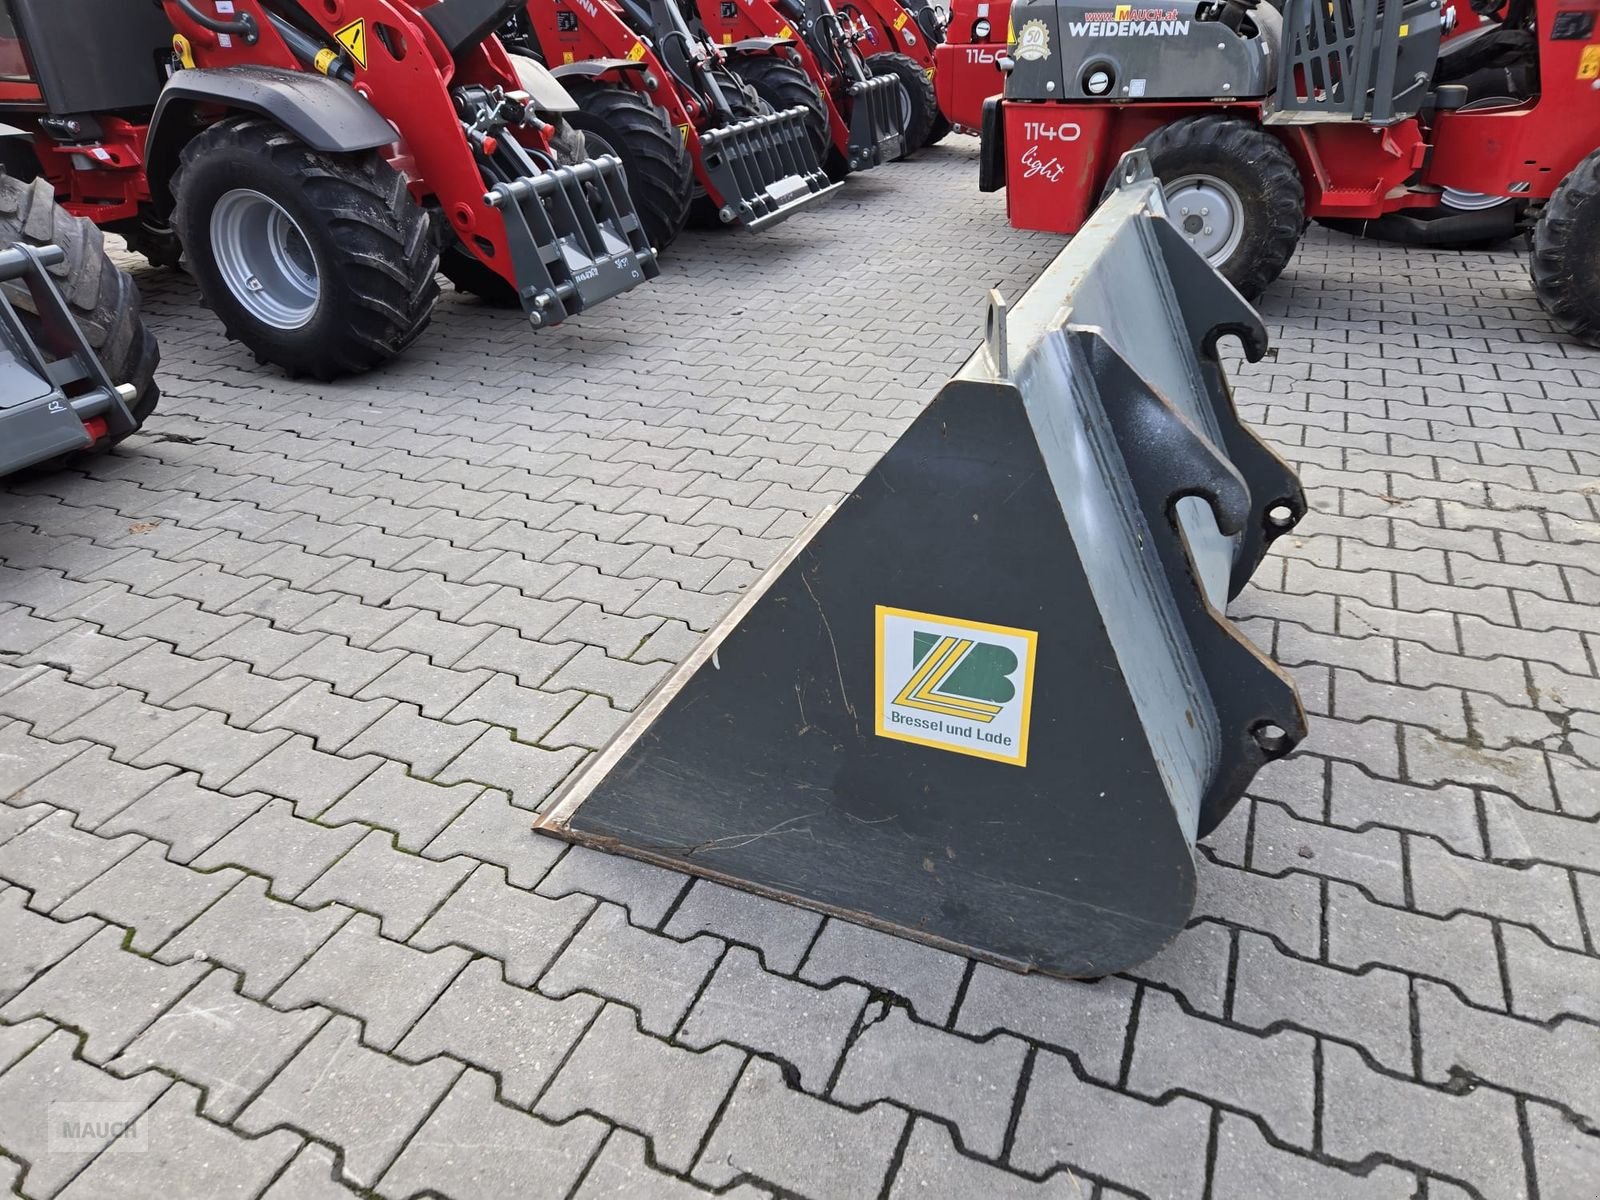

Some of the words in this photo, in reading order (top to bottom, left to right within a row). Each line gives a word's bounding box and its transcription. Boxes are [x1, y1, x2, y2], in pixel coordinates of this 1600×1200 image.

[1068, 20, 1190, 37] WEIDEMANN
[1024, 122, 1081, 142] 1140
[1021, 145, 1065, 182] light
[890, 710, 943, 732] Bressel
[946, 724, 972, 738] und
[976, 728, 1012, 747] Lade
